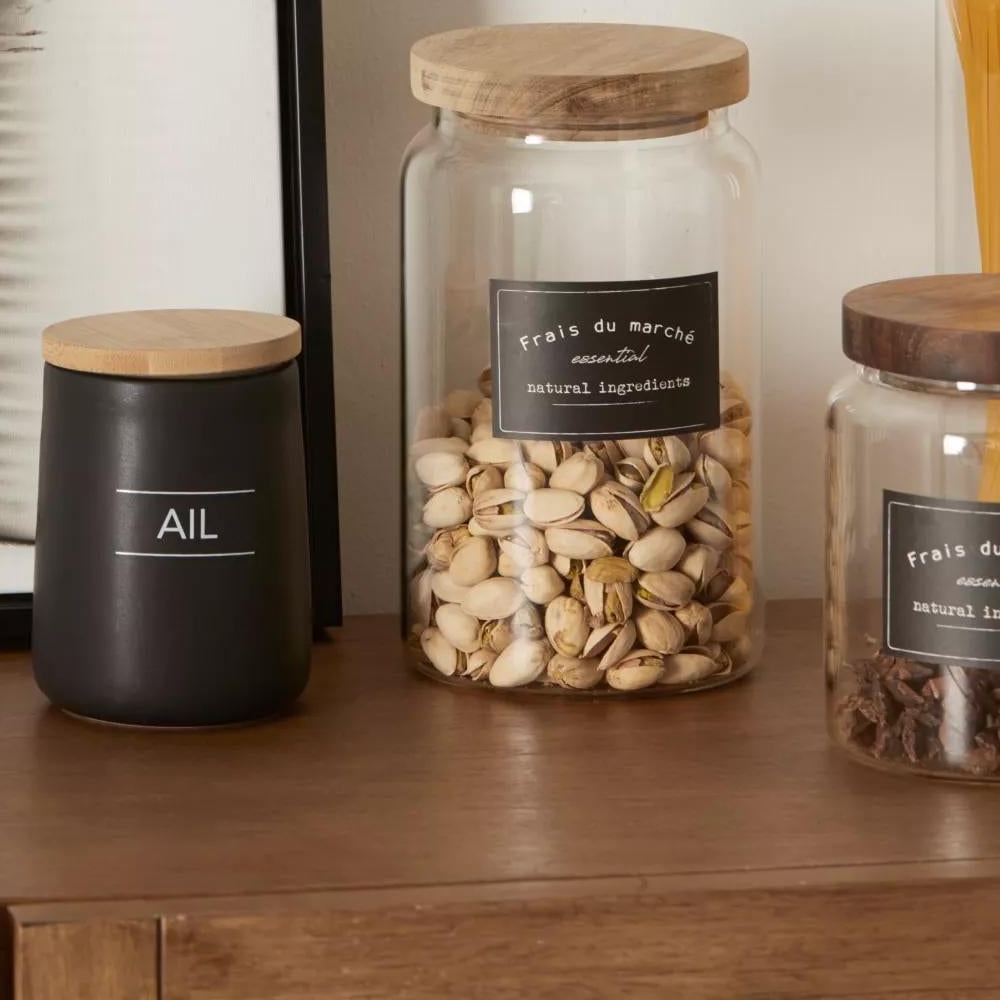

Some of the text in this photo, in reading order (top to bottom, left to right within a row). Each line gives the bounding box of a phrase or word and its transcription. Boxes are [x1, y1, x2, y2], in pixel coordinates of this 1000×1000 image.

[519, 318, 695, 352] Frais du marché
[571, 344, 650, 364] essential
[527, 376, 691, 396] natural ingredients
[157, 508, 218, 539] AIL
[907, 543, 966, 568] Frais
[913, 600, 976, 618] natural
